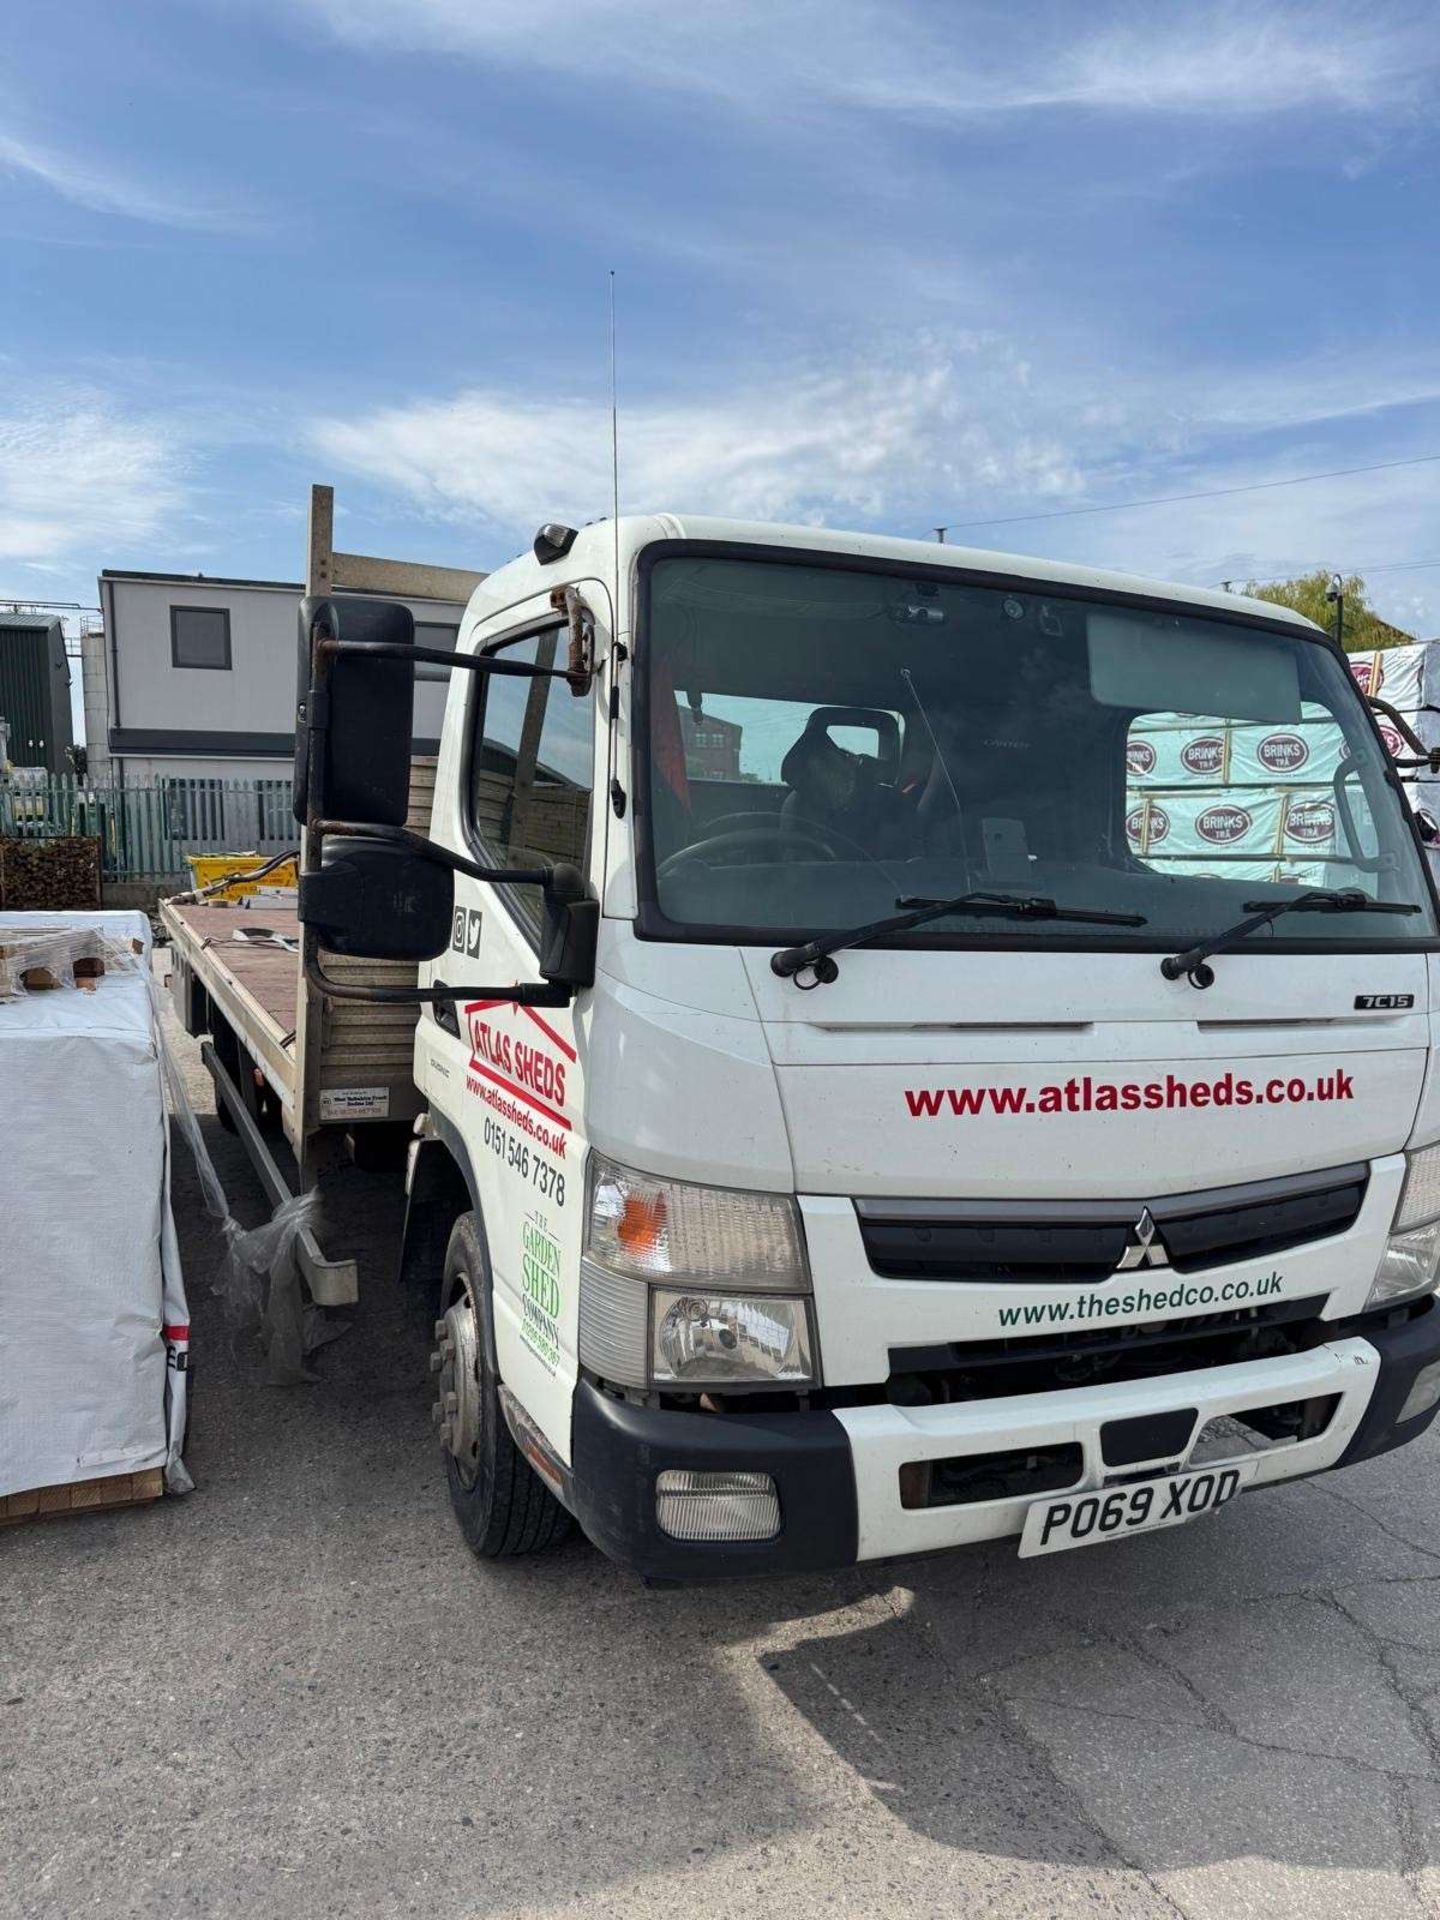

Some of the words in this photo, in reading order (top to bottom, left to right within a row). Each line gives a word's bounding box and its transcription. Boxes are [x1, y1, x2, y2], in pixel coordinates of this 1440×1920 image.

[1264, 743, 1300, 757] BRINKS
[1203, 815, 1243, 829] BRINKS
[1363, 995, 1409, 1008] 7C15
[474, 1020, 512, 1075] ATLAS
[515, 1041, 566, 1107] SHEDS
[466, 1075, 568, 1159] www.atlassheds.co.uk
[904, 1068, 1355, 1117] www.atlassheds.co.uk
[484, 1117, 507, 1160] 0151
[508, 1136, 529, 1179] 546
[533, 1155, 565, 1207] 7378
[522, 1221, 561, 1277] GARDEN
[522, 1253, 560, 1319] SHED
[998, 1271, 1284, 1327] www.theshedco.co.uk
[522, 1293, 559, 1350] COMPANY
[1040, 1487, 1154, 1546] PO69
[1160, 1469, 1240, 1519] XOD
